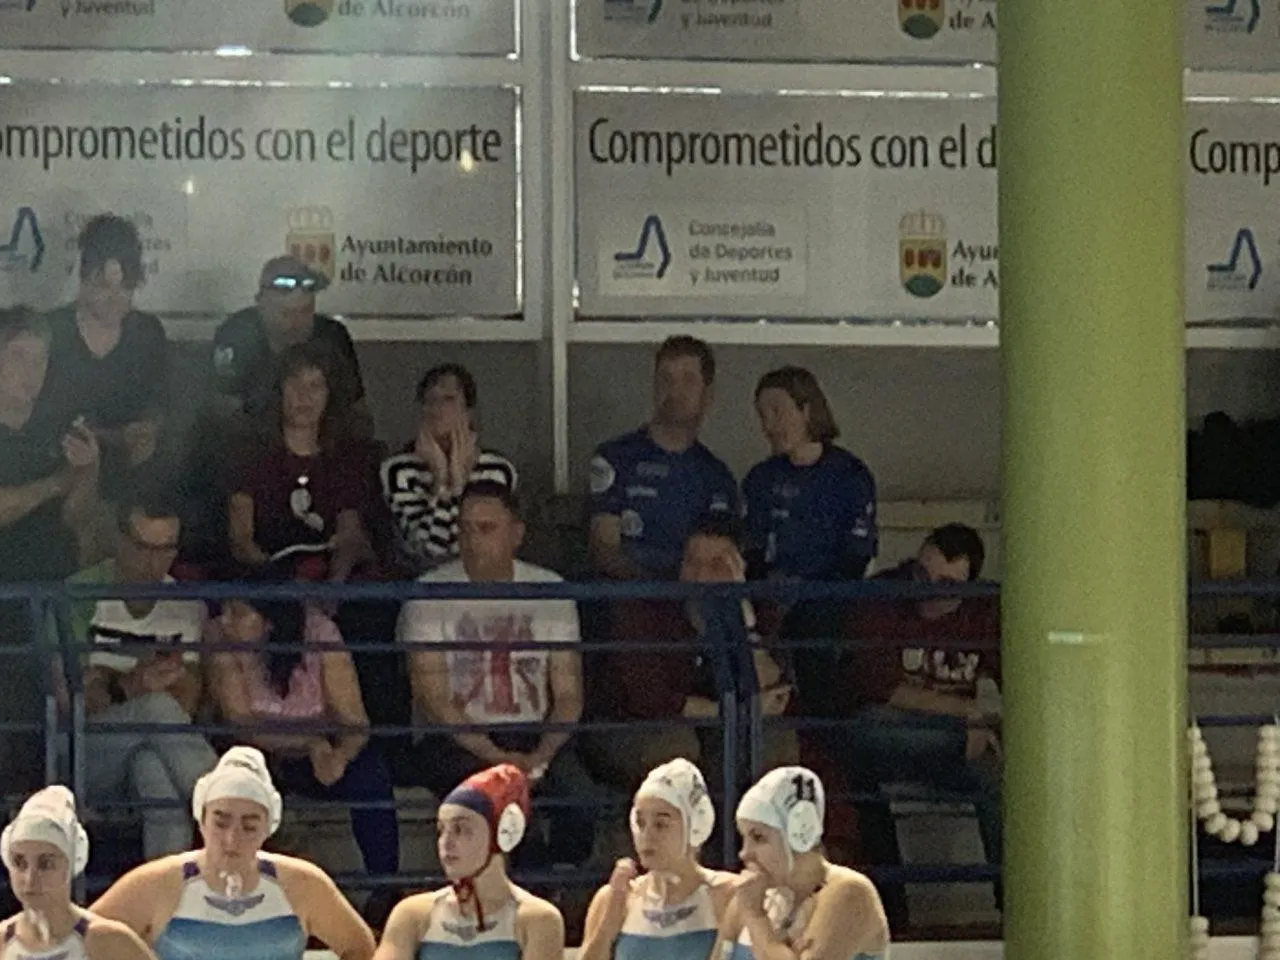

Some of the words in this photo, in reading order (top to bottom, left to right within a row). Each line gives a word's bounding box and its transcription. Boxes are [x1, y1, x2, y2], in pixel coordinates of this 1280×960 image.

[256, 121, 315, 161] con
[326, 118, 355, 162] el
[365, 116, 501, 174] deporte
[588, 117, 862, 176] Comprometidos
[870, 129, 929, 169] con
[938, 125, 968, 169] el
[340, 233, 494, 265] Ayuntamiento
[340, 261, 367, 282] de
[372, 261, 473, 286] Alcorcón
[791, 774, 816, 802] 11
